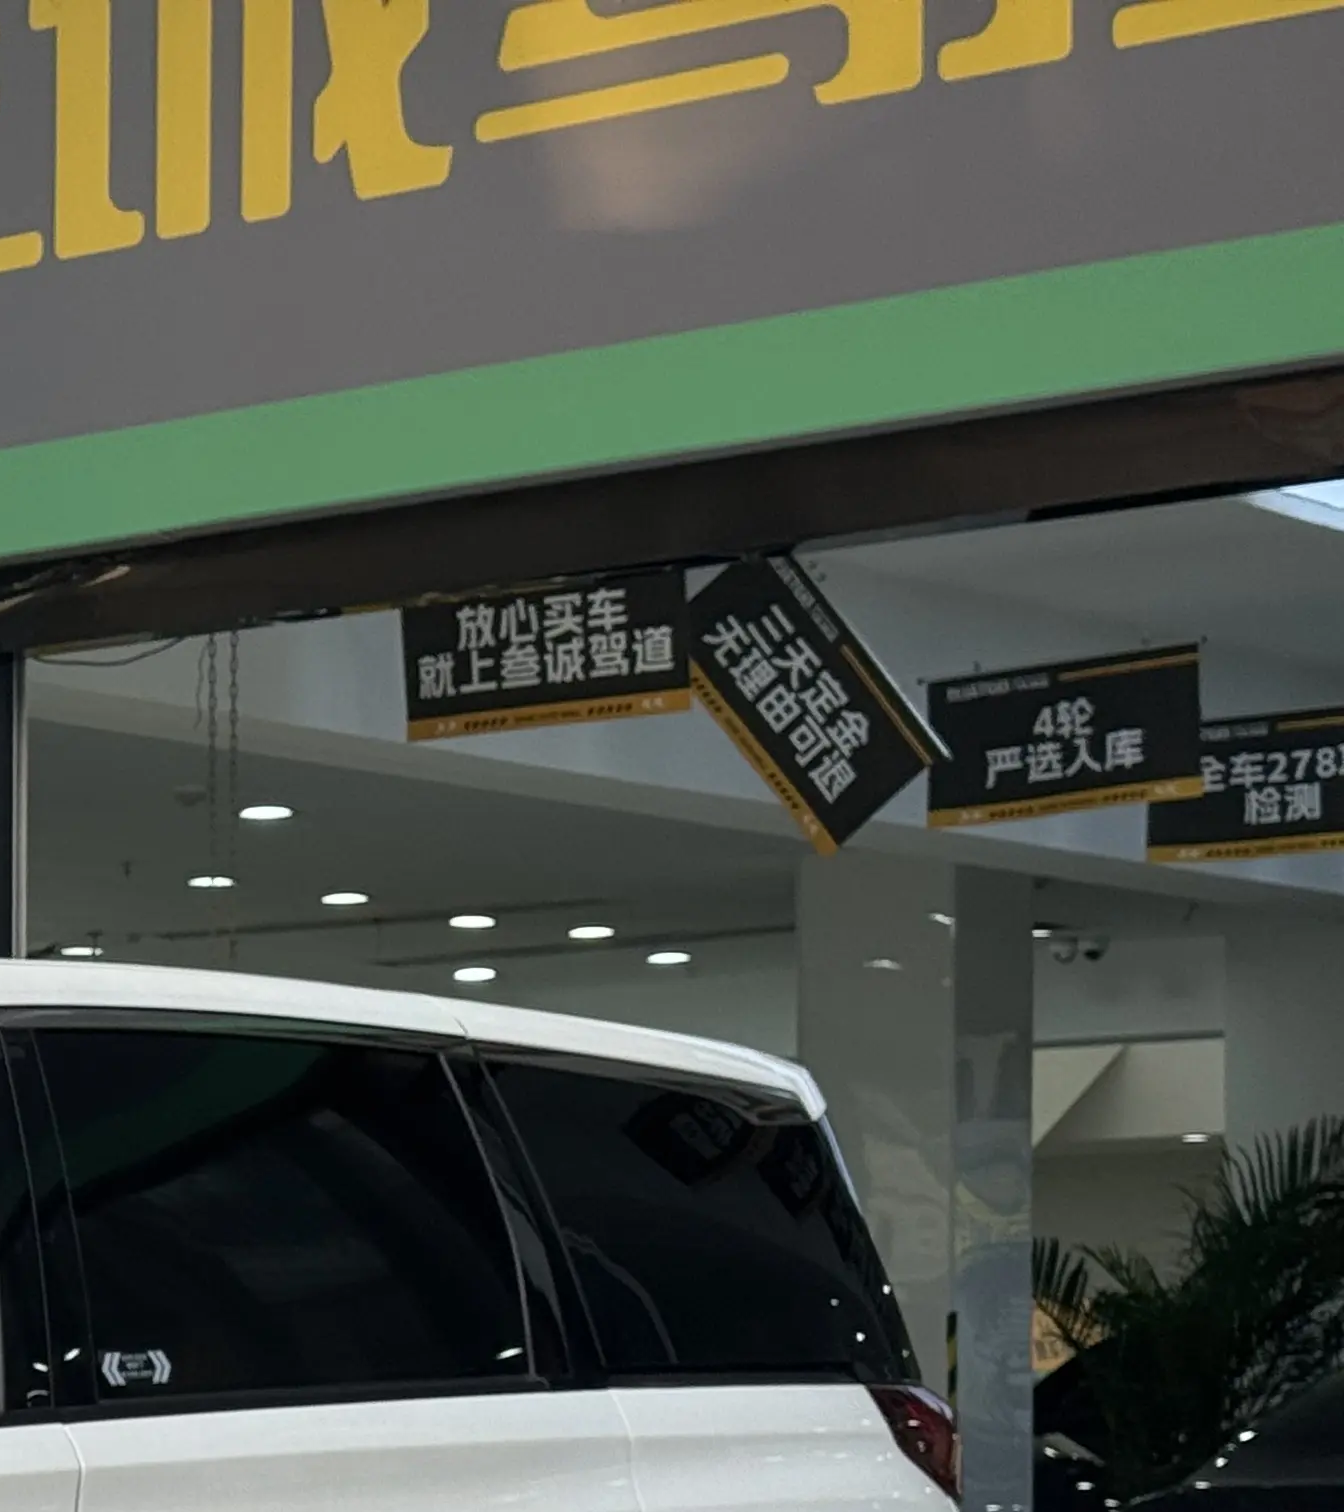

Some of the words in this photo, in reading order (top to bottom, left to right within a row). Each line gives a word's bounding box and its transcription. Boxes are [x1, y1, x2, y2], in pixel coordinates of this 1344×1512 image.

[456, 587, 629, 650] 放心买车
[417, 625, 675, 699] 就上叁诚驾道
[746, 603, 870, 758] 三天定金
[700, 614, 857, 805] 无理由可退
[1032, 695, 1096, 740] 4轮
[984, 727, 1147, 790] 严选入库
[1243, 781, 1322, 826] 检测
